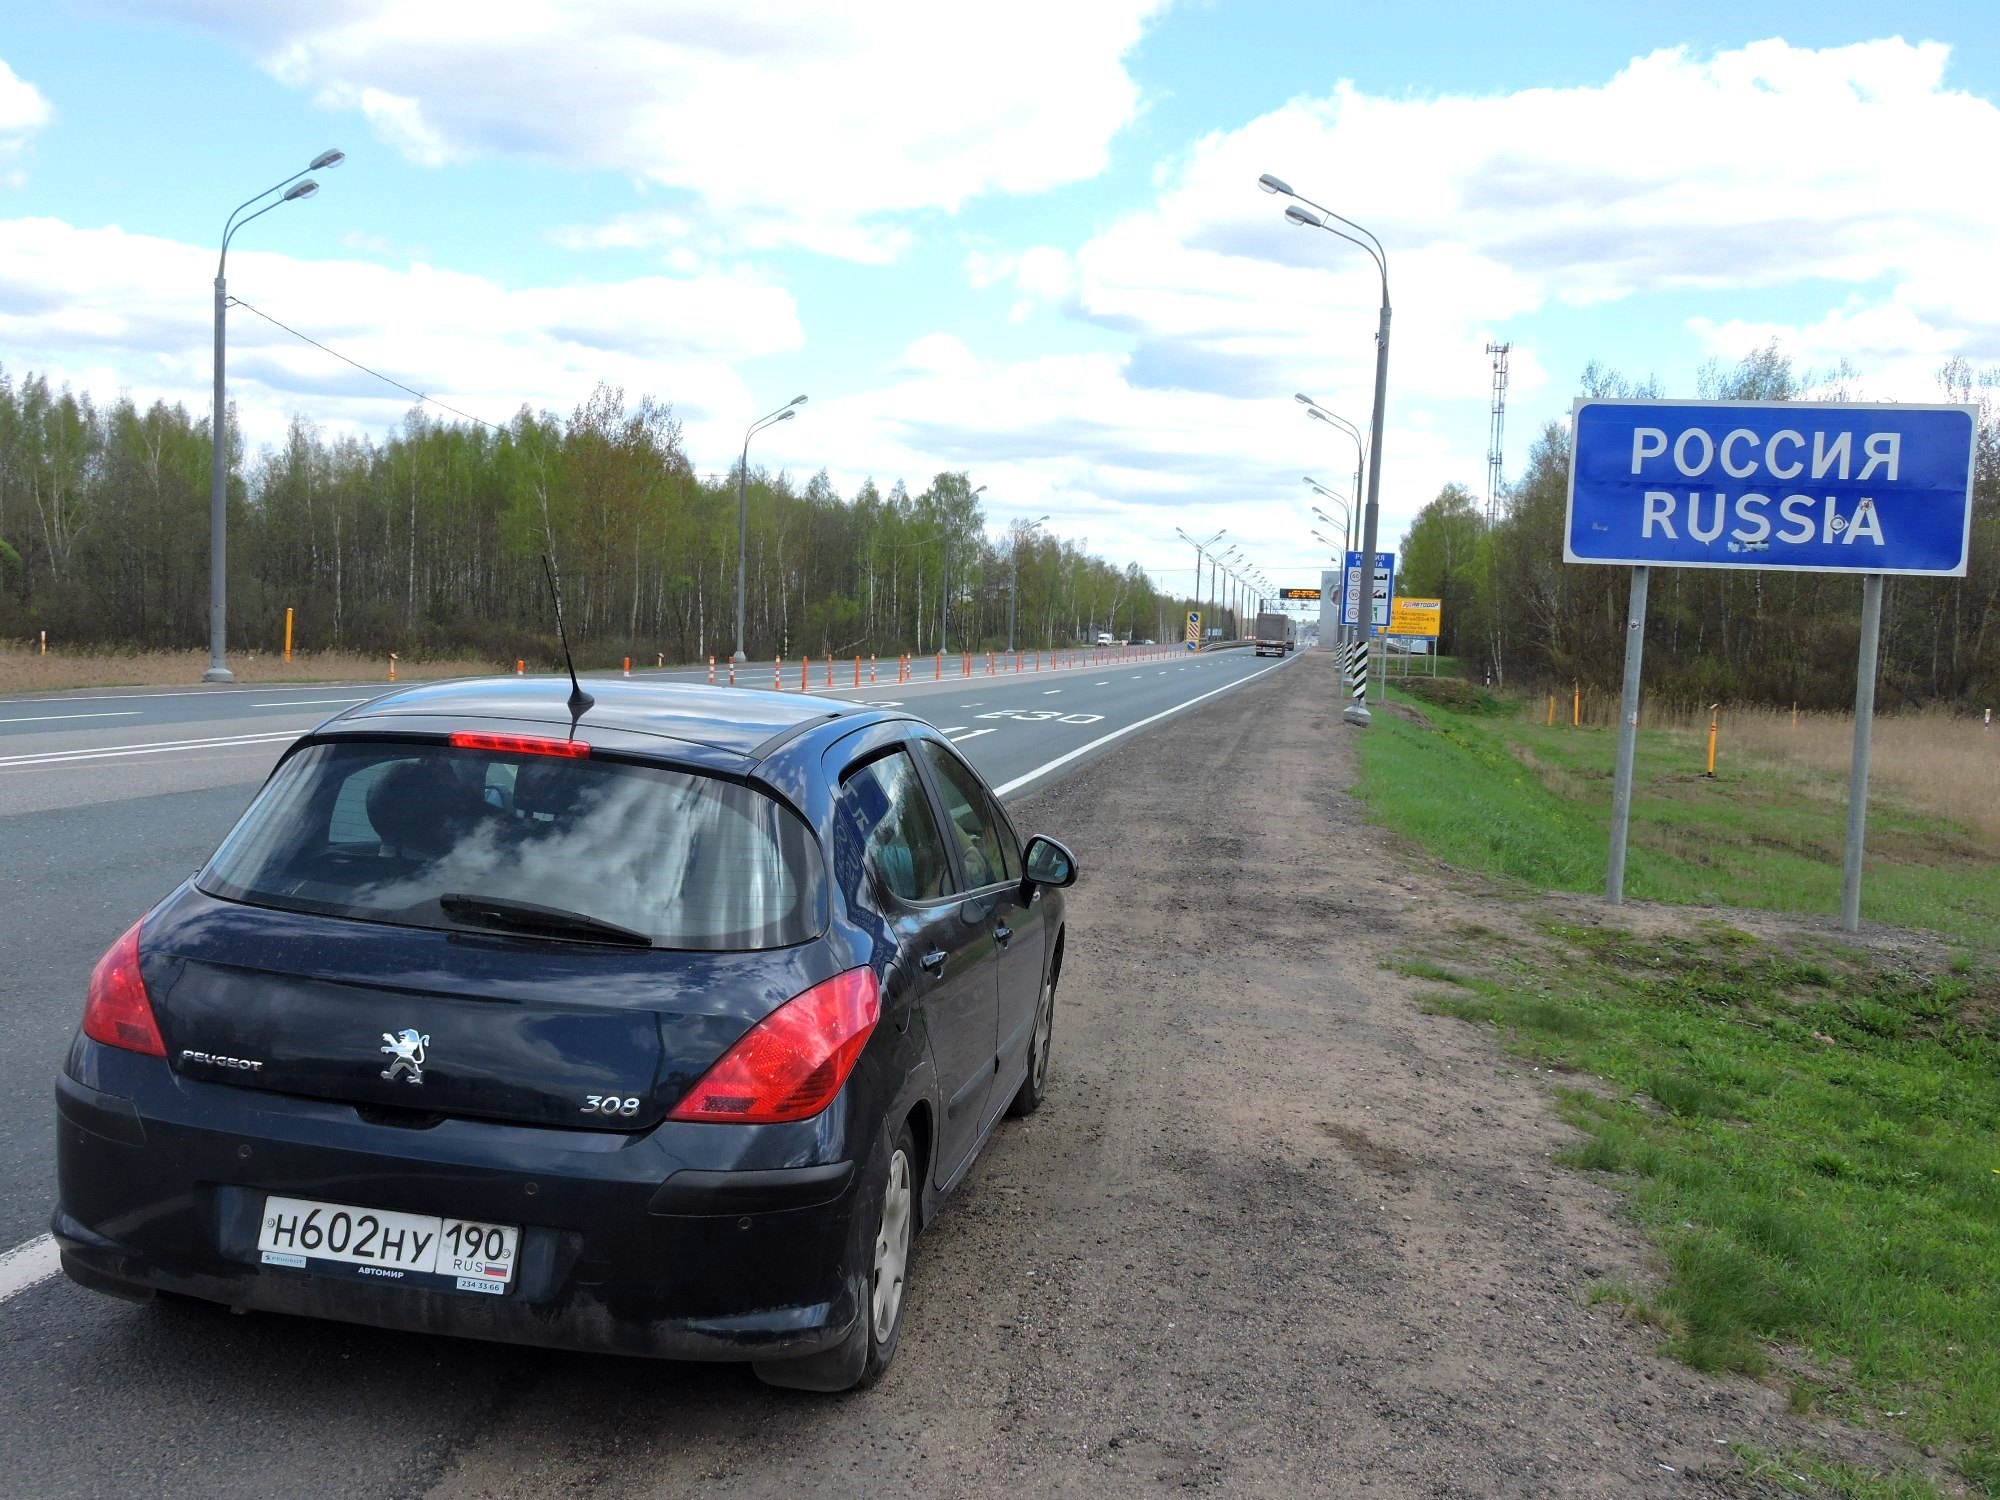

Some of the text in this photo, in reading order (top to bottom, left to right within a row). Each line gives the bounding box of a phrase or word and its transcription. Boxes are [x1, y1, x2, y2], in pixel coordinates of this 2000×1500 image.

[1631, 427, 1901, 481] РОССИЯ
[1642, 491, 1885, 546] RUSSIA
[973, 709, 1106, 724] E30
[182, 1049, 263, 1072] PEUGEOT
[580, 1094, 640, 1117] 308
[446, 1222, 504, 1261] 190
[358, 1266, 404, 1279] АВТОМИР
[453, 1258, 483, 1273] RUS
[461, 1280, 500, 1291] 234 33 66
